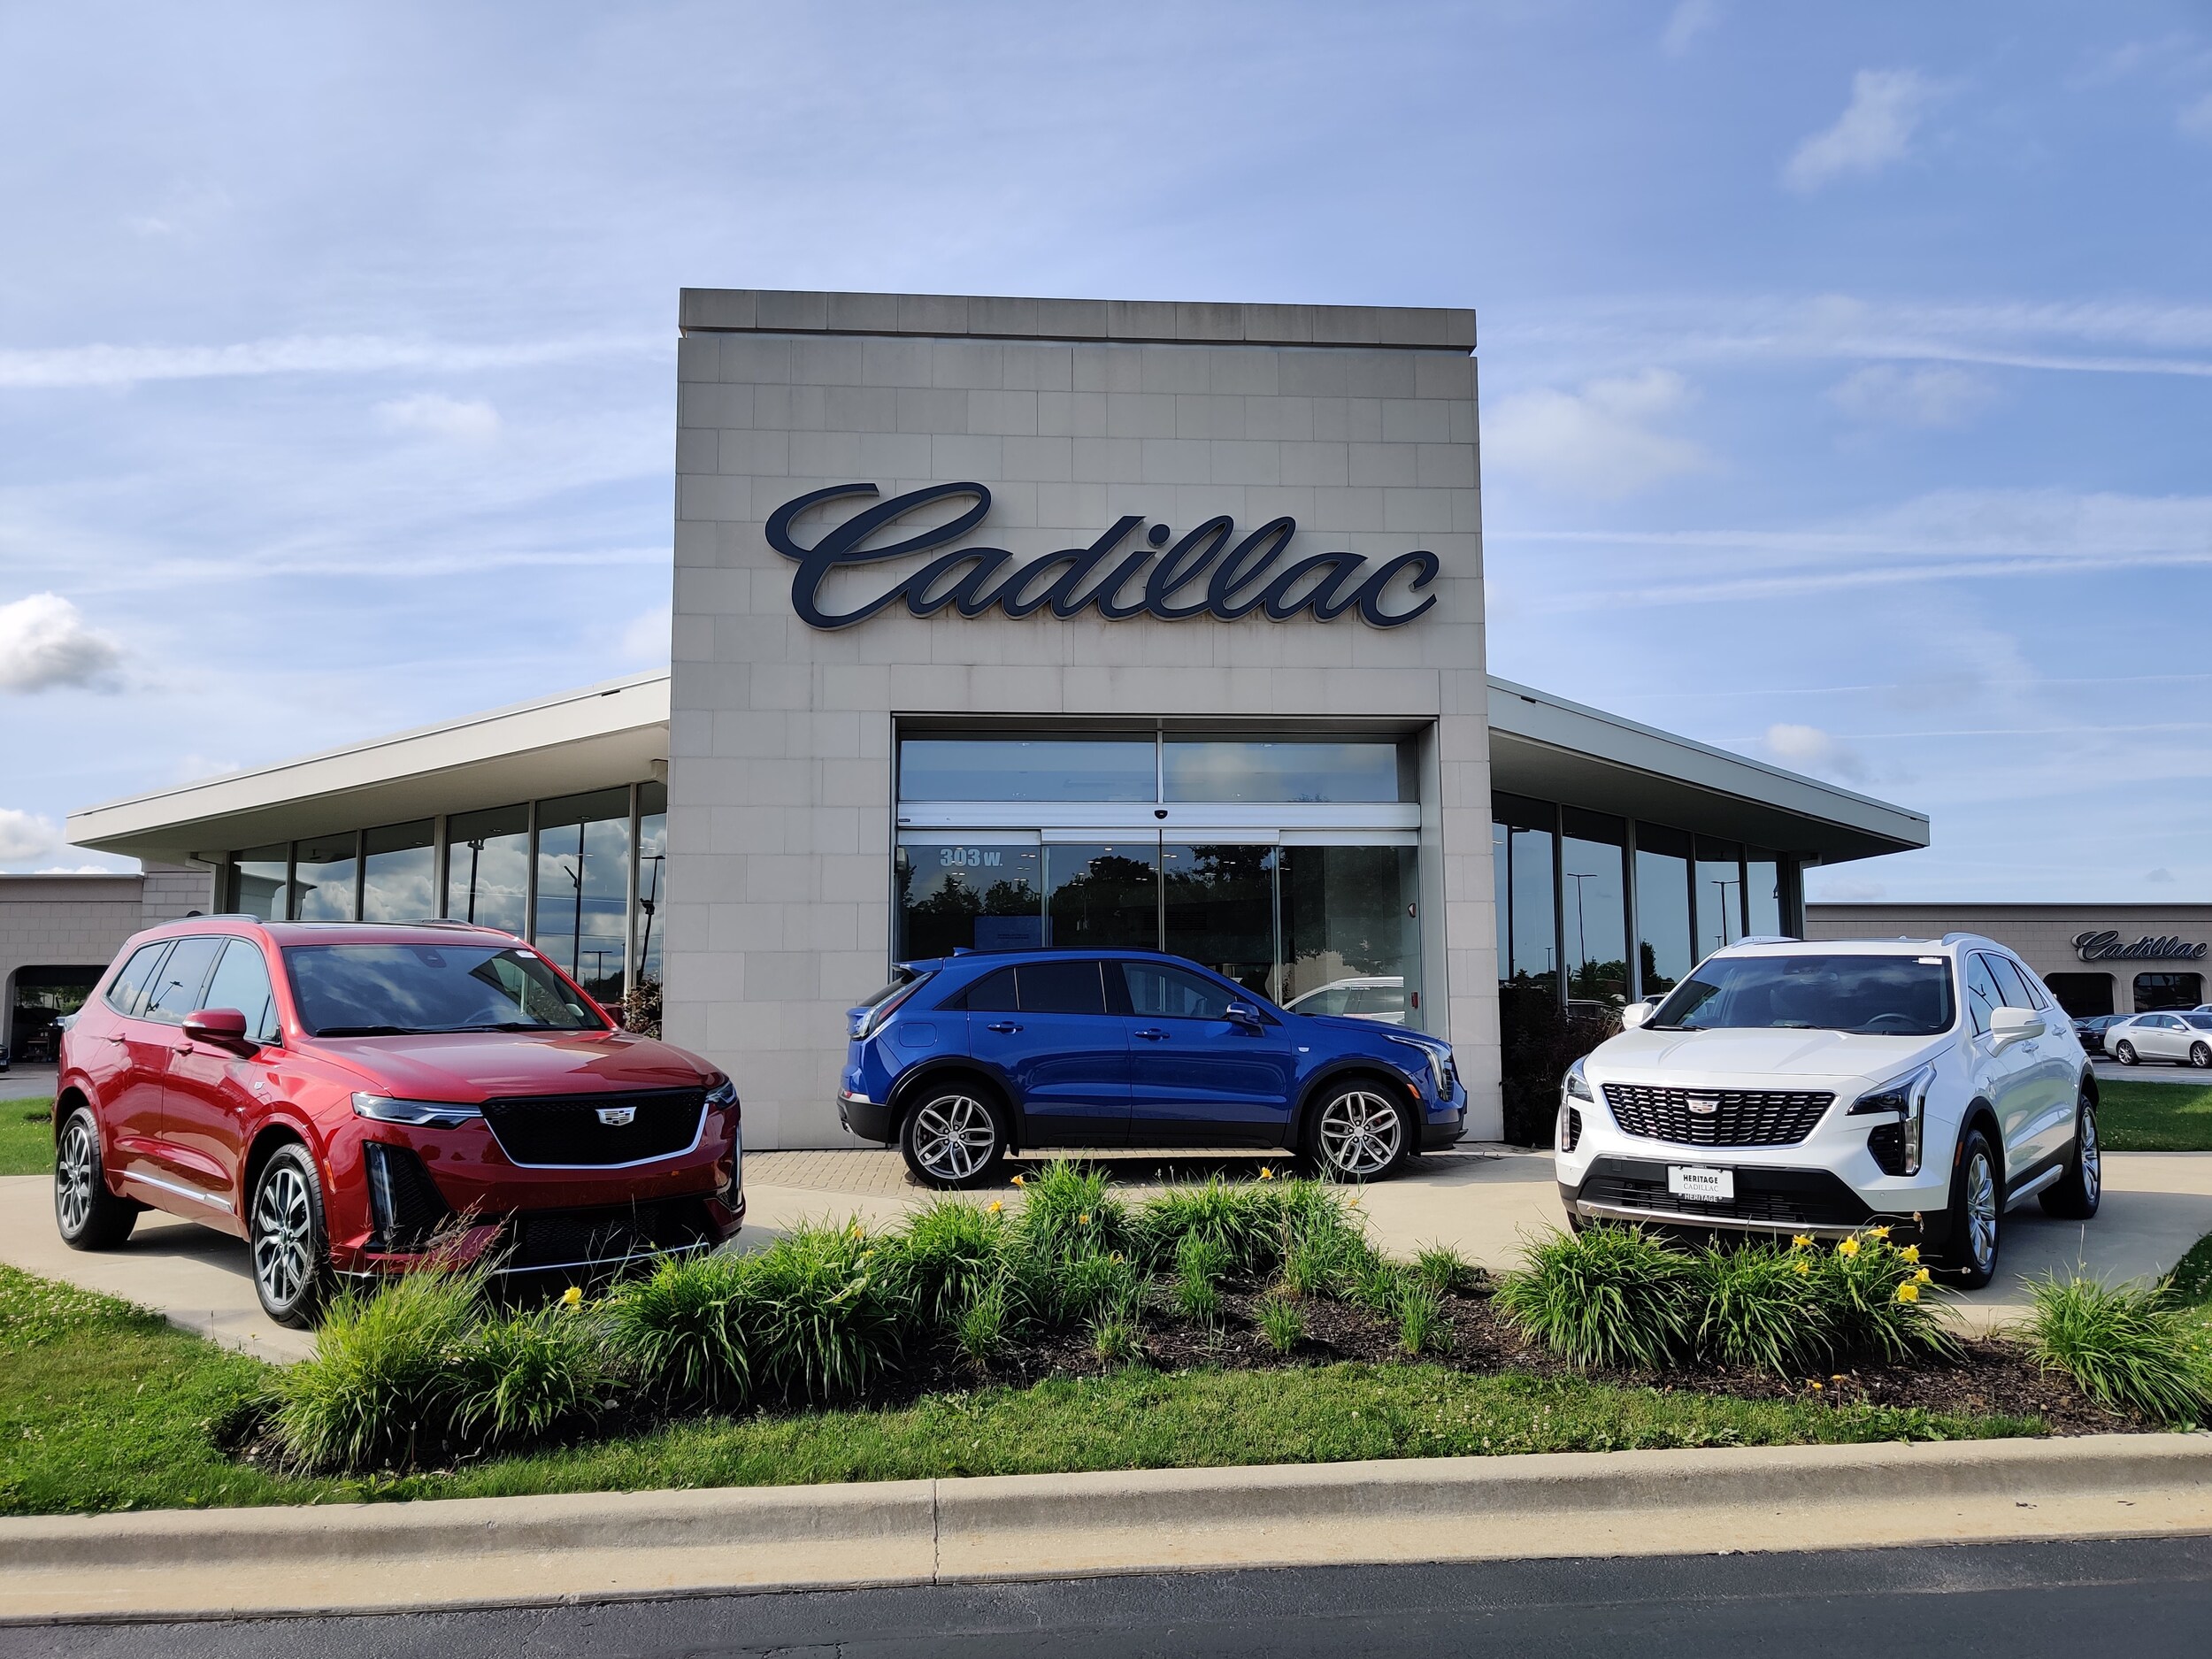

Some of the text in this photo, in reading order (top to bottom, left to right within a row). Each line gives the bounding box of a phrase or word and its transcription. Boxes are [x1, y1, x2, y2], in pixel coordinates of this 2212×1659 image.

[765, 481, 1440, 630] Cadillac
[940, 849, 980, 866] 303
[2071, 931, 2208, 962] Cadillac
[1683, 1174, 1718, 1184] HERITAGE
[1683, 1183, 1719, 1192] CADILLAC
[1684, 1193, 1718, 1202] HERITAGE
